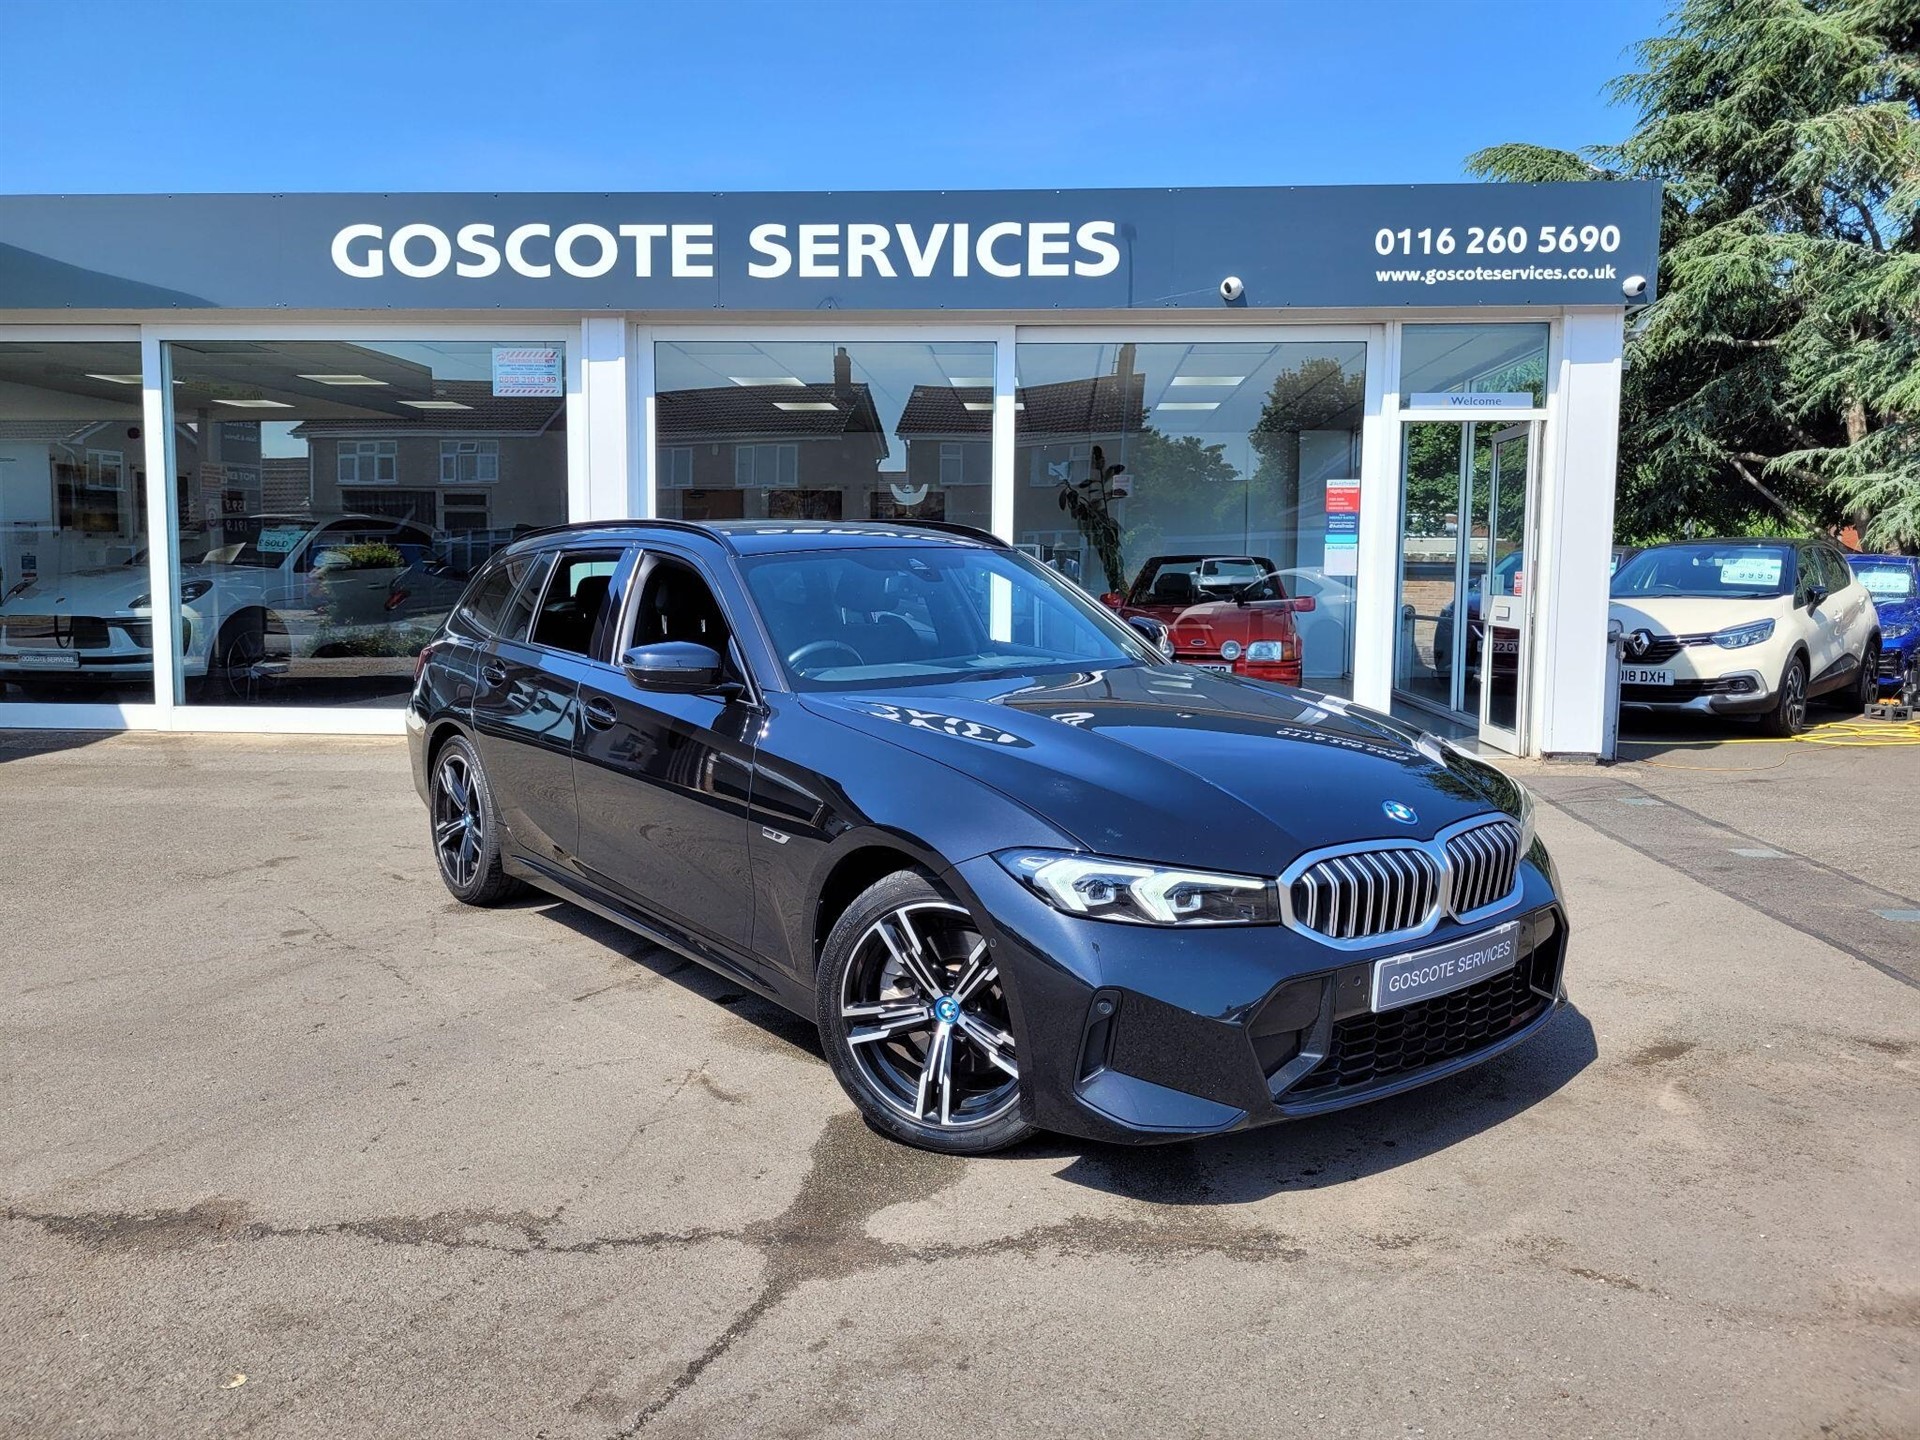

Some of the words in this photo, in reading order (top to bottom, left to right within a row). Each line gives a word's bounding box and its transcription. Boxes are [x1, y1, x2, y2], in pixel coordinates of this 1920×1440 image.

[1375, 228, 1456, 255] 0116
[1466, 226, 1528, 254] 260
[1538, 225, 1621, 253] 5690
[331, 223, 713, 278] GOSCOTE
[748, 221, 1121, 279] SERVICES
[1376, 264, 1616, 284] www.goscoteservices.co.uk
[1451, 396, 1502, 406] Welcome
[265, 540, 289, 548] SOLD
[1507, 643, 1519, 652] GY
[1640, 670, 1666, 683] DXH
[1389, 960, 1456, 992] GOSCOTE
[1457, 940, 1511, 973] SERVICES
